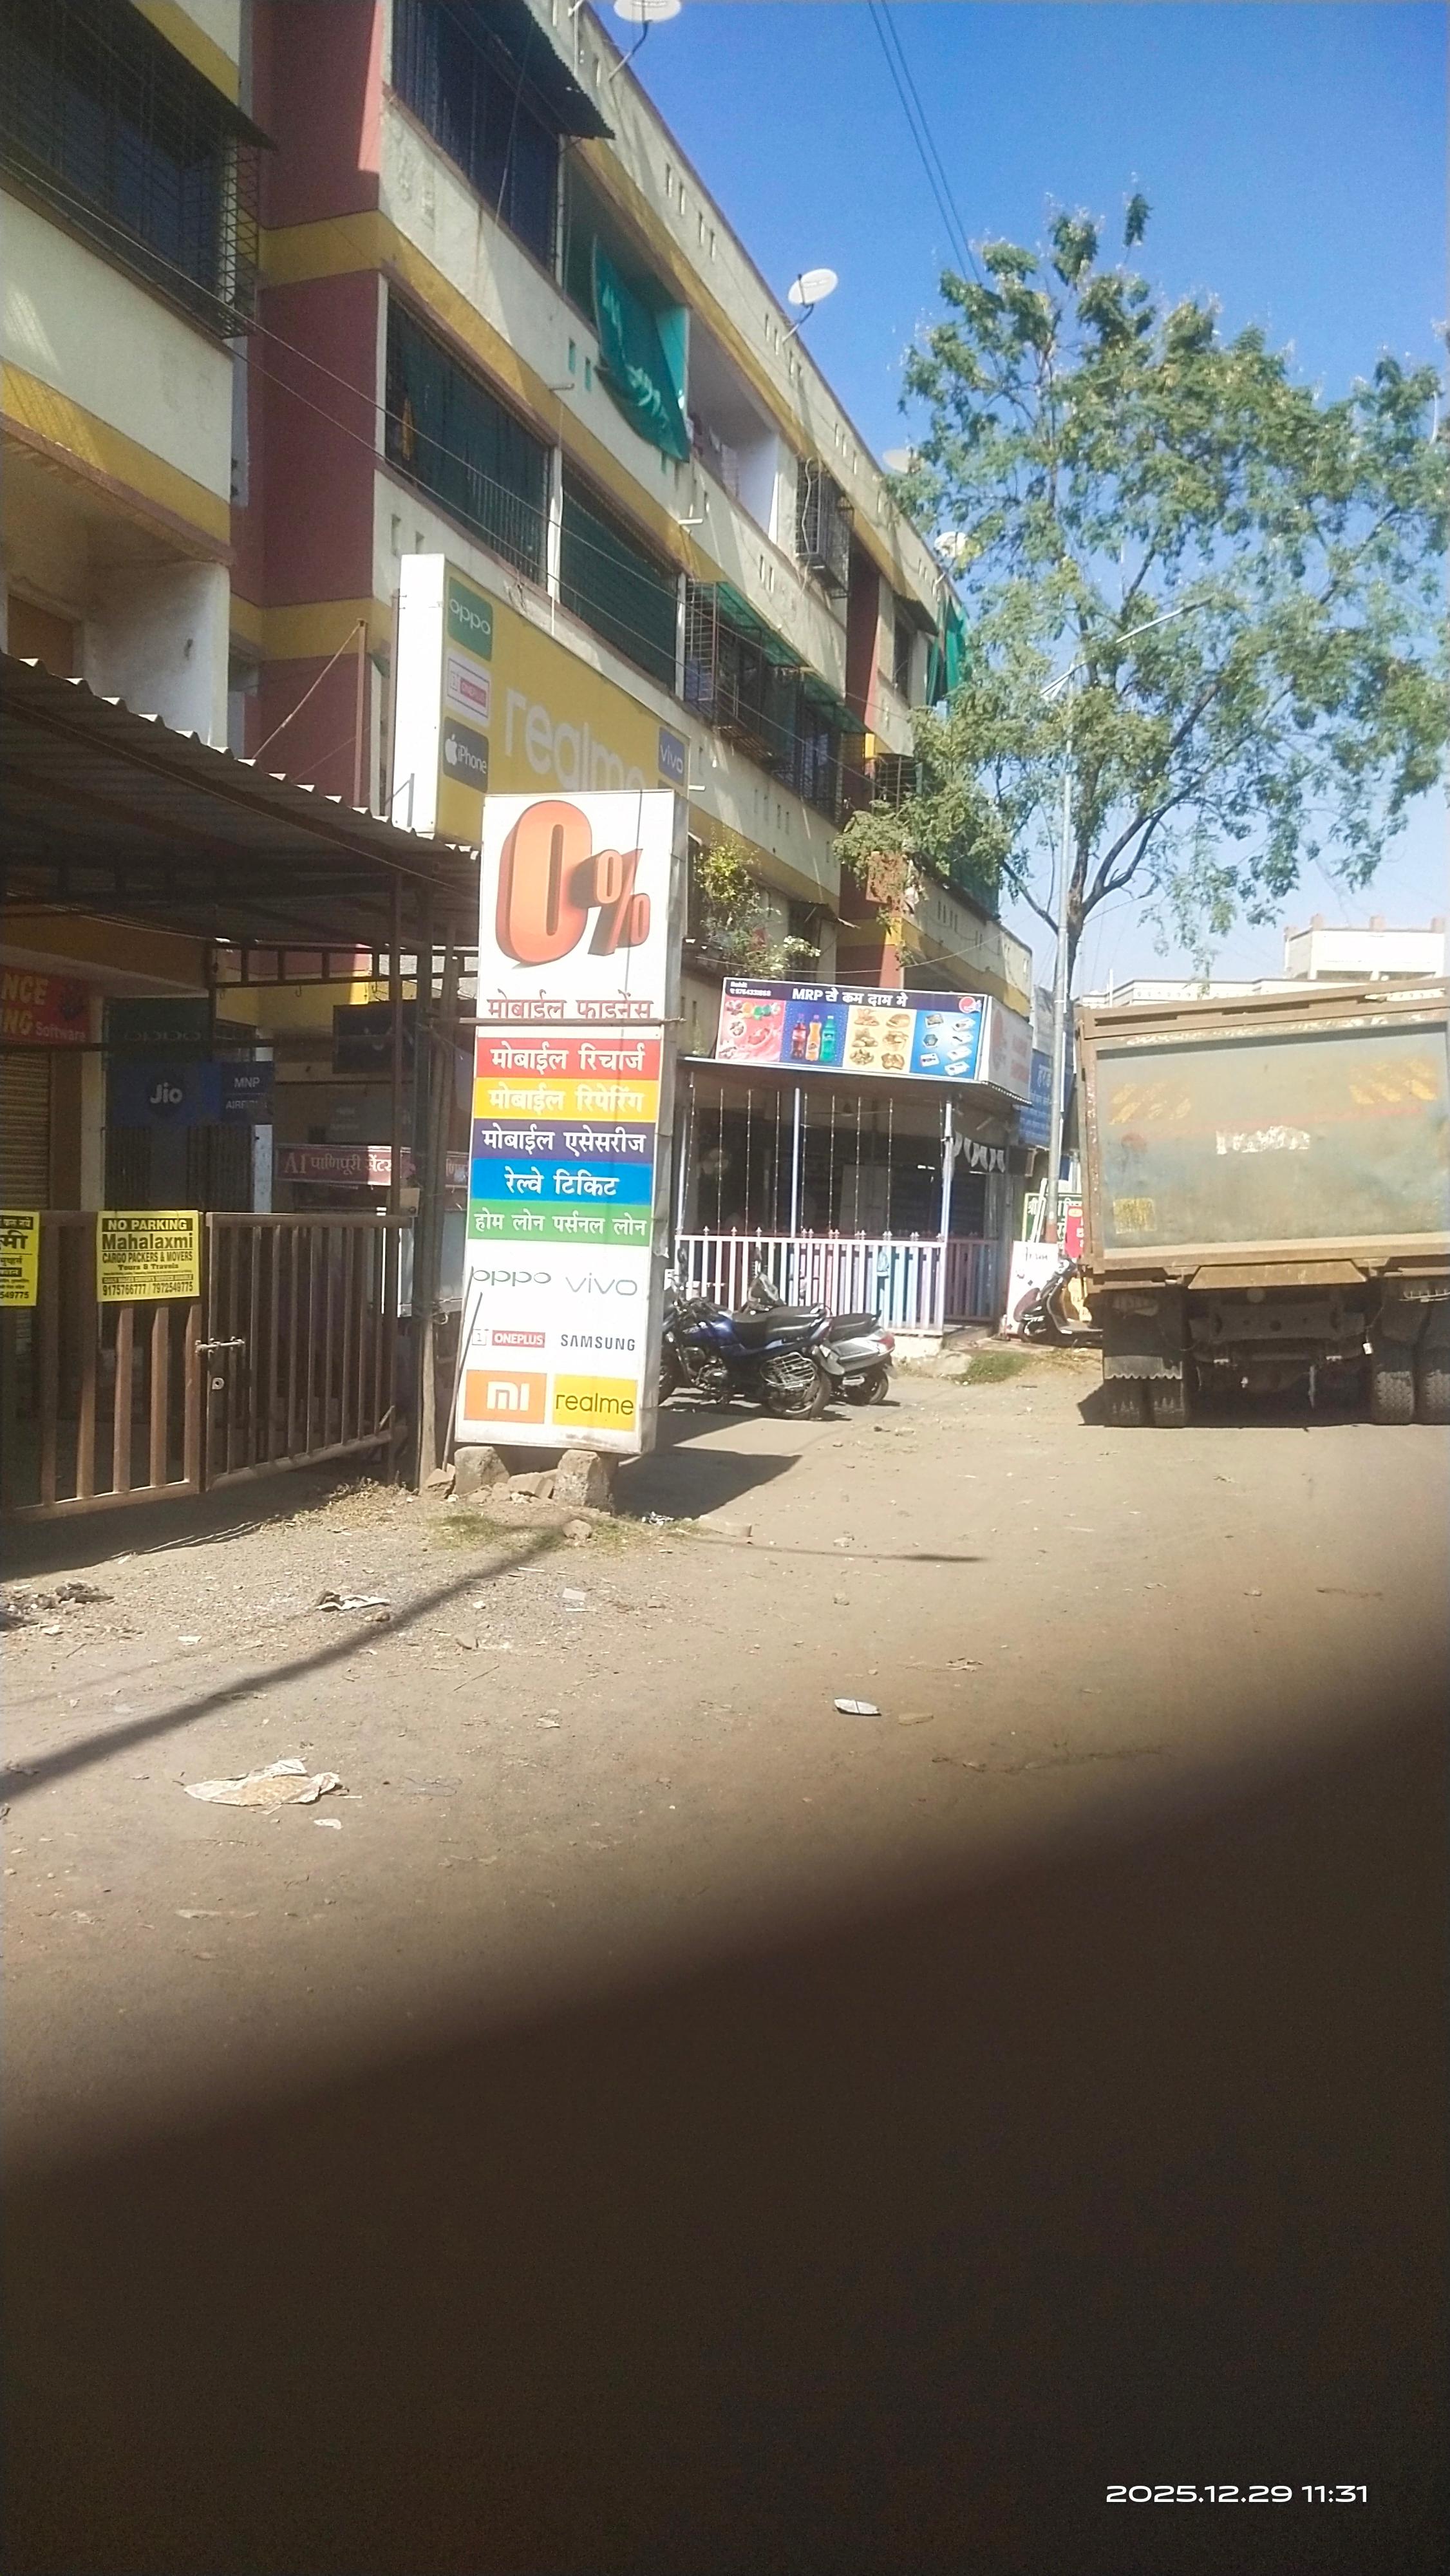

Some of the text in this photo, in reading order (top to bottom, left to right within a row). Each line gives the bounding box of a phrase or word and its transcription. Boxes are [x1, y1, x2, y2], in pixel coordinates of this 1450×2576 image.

[450, 598, 491, 636] oppo
[458, 747, 487, 773] iPhone
[659, 744, 683, 773] vivo
[495, 799, 651, 968] 0%
[792, 988, 824, 1001] MRP
[825, 987, 839, 1002] से
[842, 992, 865, 1004] कम
[867, 993, 893, 1006] दाम
[490, 1041, 645, 1075] मोबाईल रिचार्ज
[150, 1082, 184, 1104] Jio
[234, 1077, 260, 1088] MNP
[487, 1081, 645, 1115] मोबाईल रिपेरिंग
[482, 1122, 647, 1157] मोबाईल एसेसरीज
[504, 1166, 545, 1195] रेल्वे
[553, 1169, 620, 1197] टिकिट
[108, 1219, 187, 1231] NO PARKING
[474, 1207, 648, 1236] होम लोन पर्सनल लोन
[102, 1233, 193, 1250] Mahalaxmi
[102, 1253, 126, 1263] CARGO
[128, 1252, 158, 1262] PACKERS
[167, 1251, 193, 1262] MOVERS
[152, 1282, 193, 1293] 7972549775
[565, 1272, 637, 1296] vivo
[494, 1333, 543, 1346] ONEPLUS
[560, 1334, 636, 1351] SAMSUNG
[556, 1393, 634, 1416] realme
